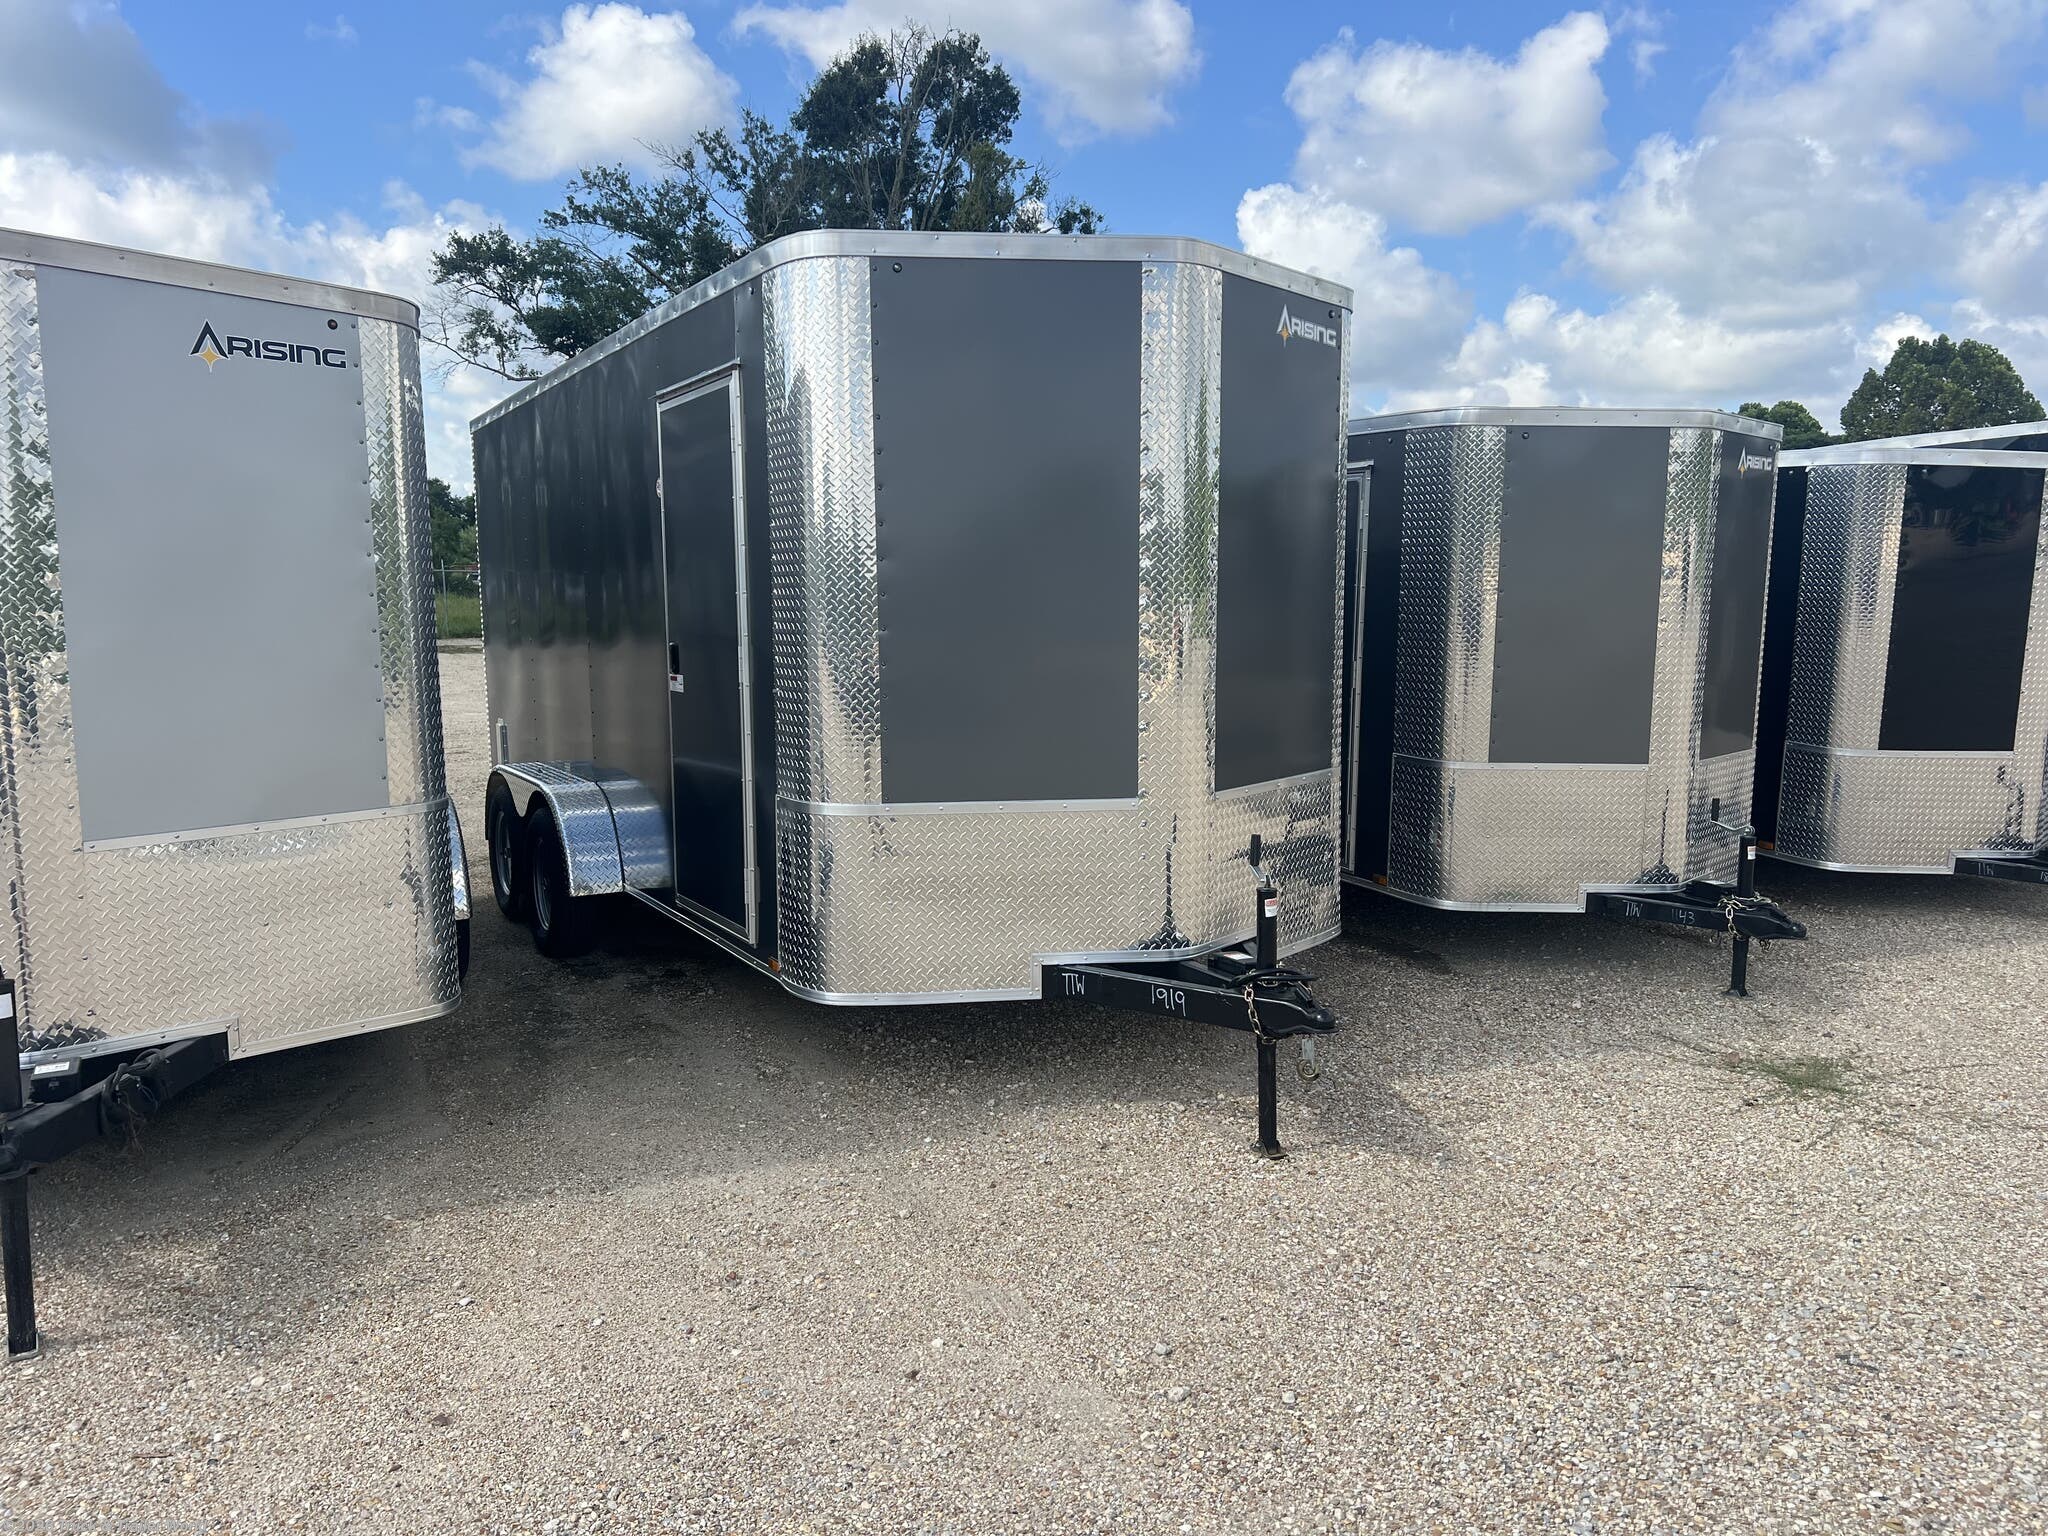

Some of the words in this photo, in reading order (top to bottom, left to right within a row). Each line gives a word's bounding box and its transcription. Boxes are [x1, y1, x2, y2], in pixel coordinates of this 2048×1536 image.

[189, 319, 348, 370] ARISING
[1276, 304, 1337, 347] ARISING
[1737, 446, 1773, 471] ARISING
[1061, 972, 1086, 996] TTW
[1150, 984, 1187, 1017] 1919
